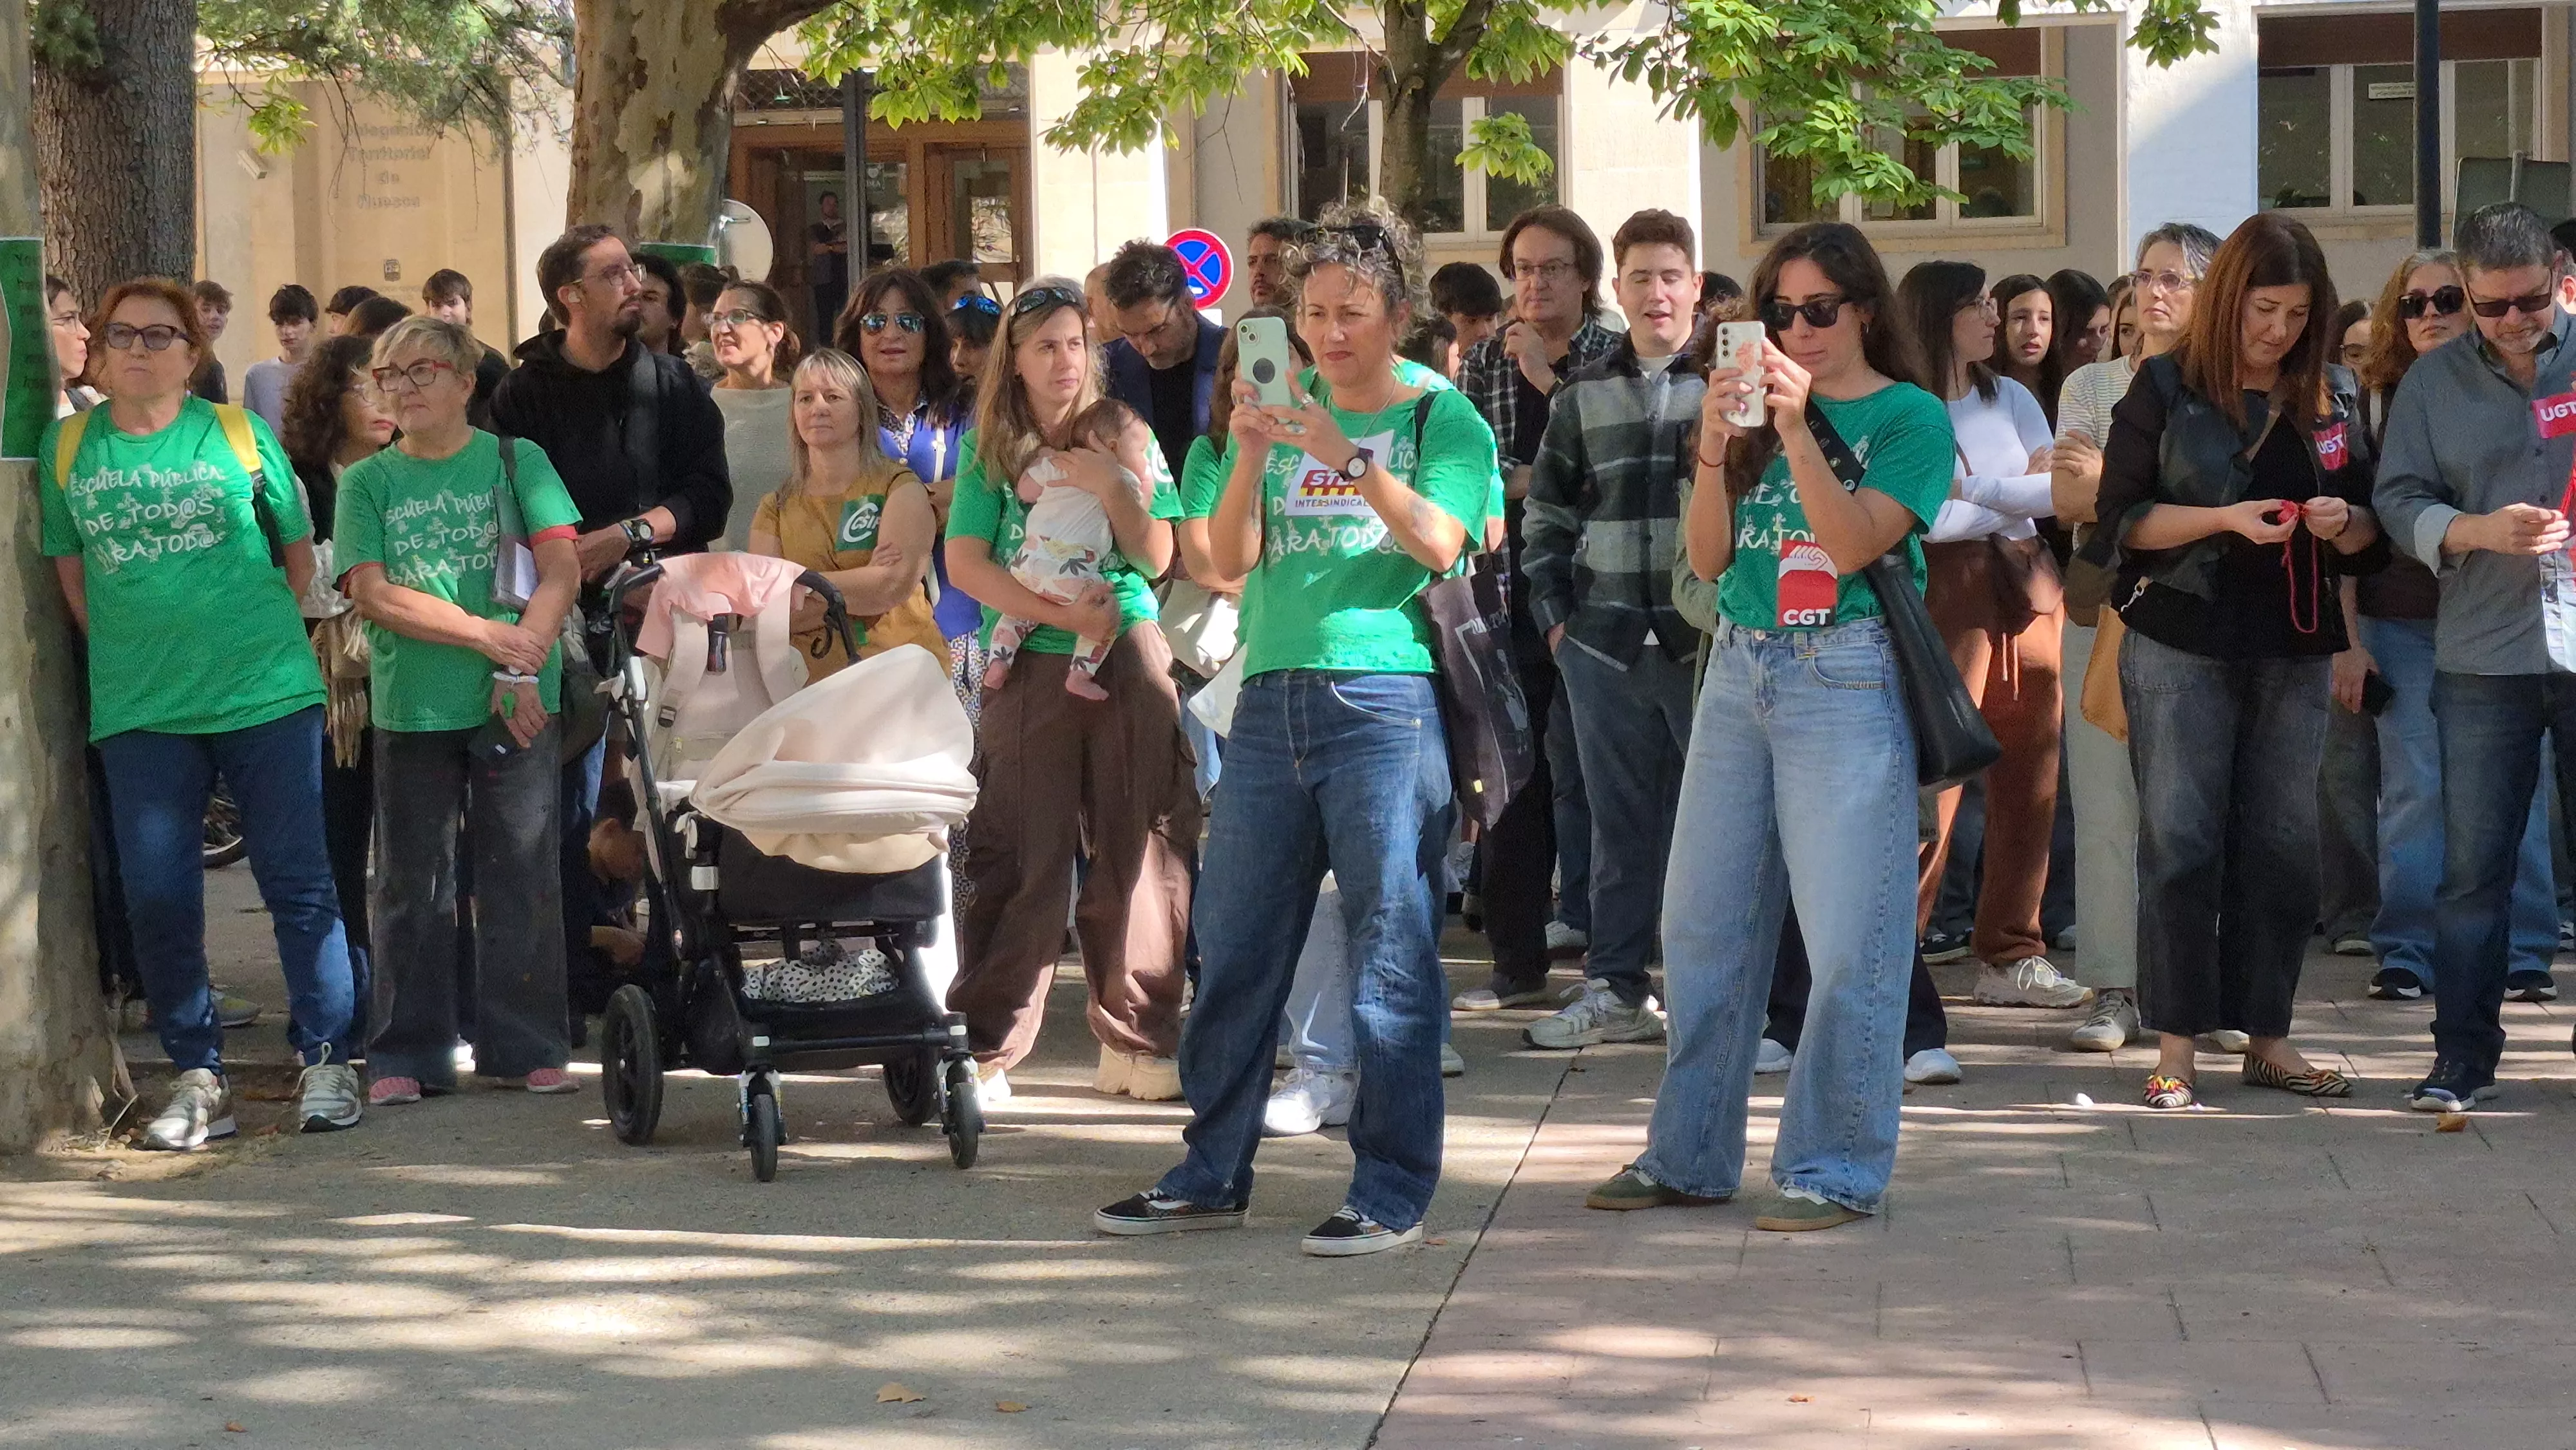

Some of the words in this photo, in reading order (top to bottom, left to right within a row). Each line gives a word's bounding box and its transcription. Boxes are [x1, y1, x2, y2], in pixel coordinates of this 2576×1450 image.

[2539, 401, 2576, 422] UGT
[2316, 433, 2344, 455] UGT
[70, 471, 143, 497] ESCUELA
[147, 465, 224, 488] PÚBLICA
[386, 493, 448, 526] SCUELA
[453, 489, 495, 514] PÚBL
[1295, 498, 1370, 508] INTERSINDICAL
[85, 513, 114, 536] DE
[127, 498, 215, 523] TOD@S
[394, 534, 423, 557] DE
[435, 521, 499, 545] TOD@
[1783, 608, 1830, 625] CGT
